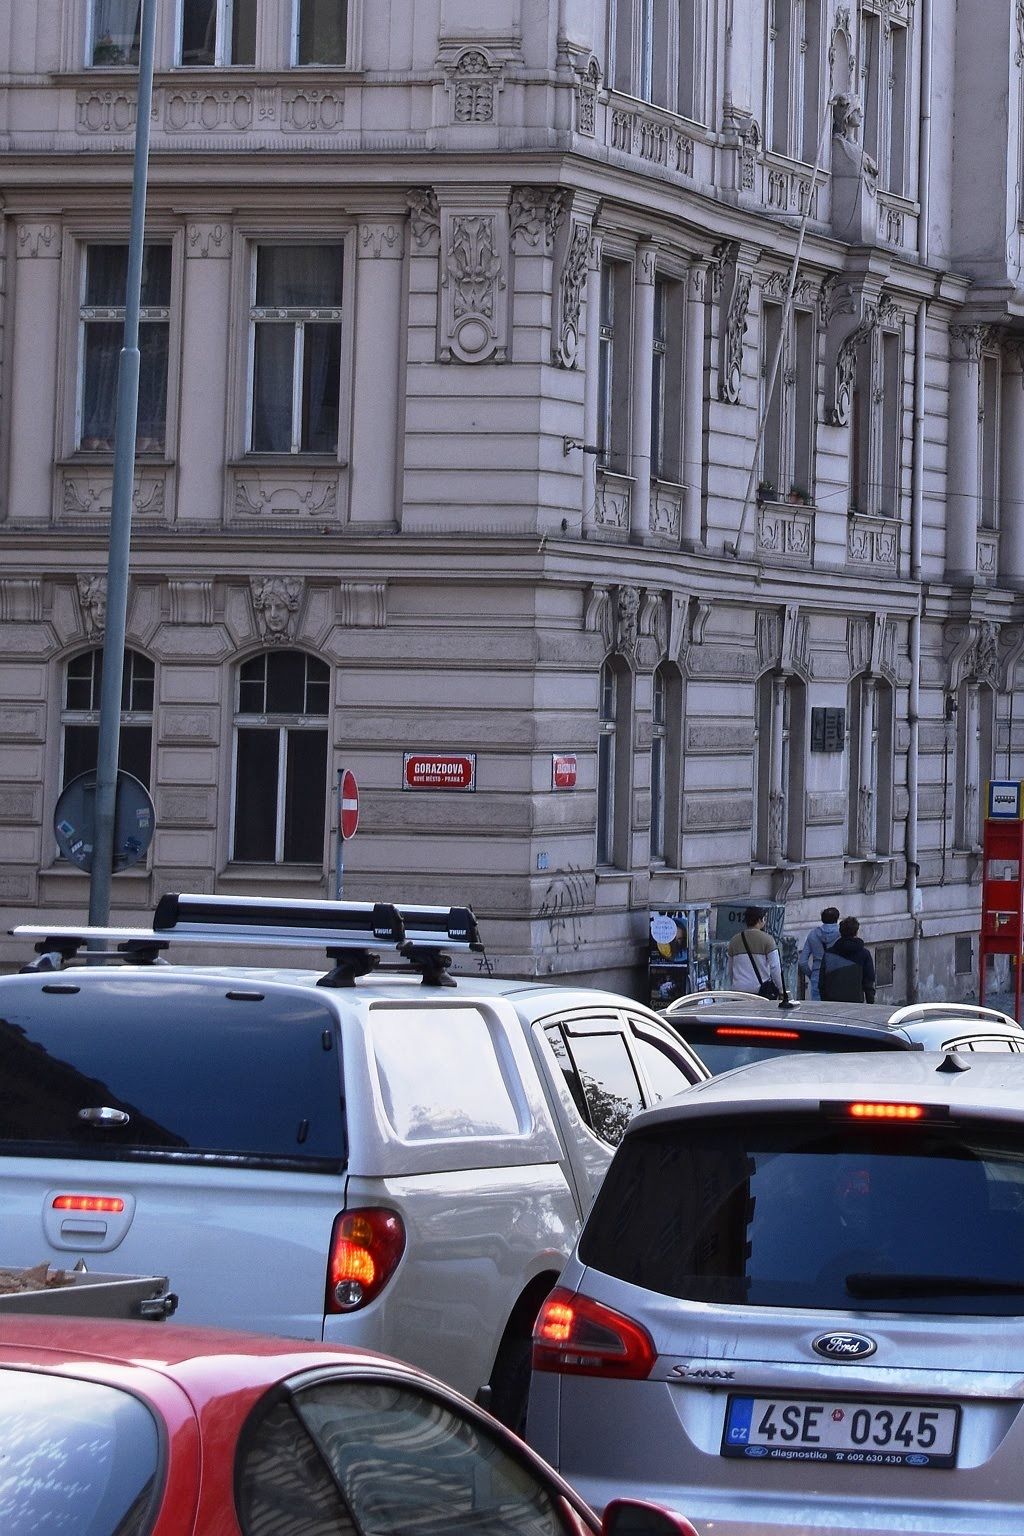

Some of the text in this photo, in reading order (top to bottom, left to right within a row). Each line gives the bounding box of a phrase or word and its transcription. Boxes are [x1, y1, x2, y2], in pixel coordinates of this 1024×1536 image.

[414, 763, 464, 775] GORAZDOVA
[826, 1337, 860, 1353] Ford
[667, 1364, 736, 1380] S-MAX
[731, 1427, 747, 1439] CZ
[758, 1404, 939, 1448] 4SE 0345
[771, 1450, 828, 1460] diagnostika
[847, 1453, 864, 1461] 602
[866, 1454, 883, 1462] 630
[885, 1455, 902, 1463] 430
